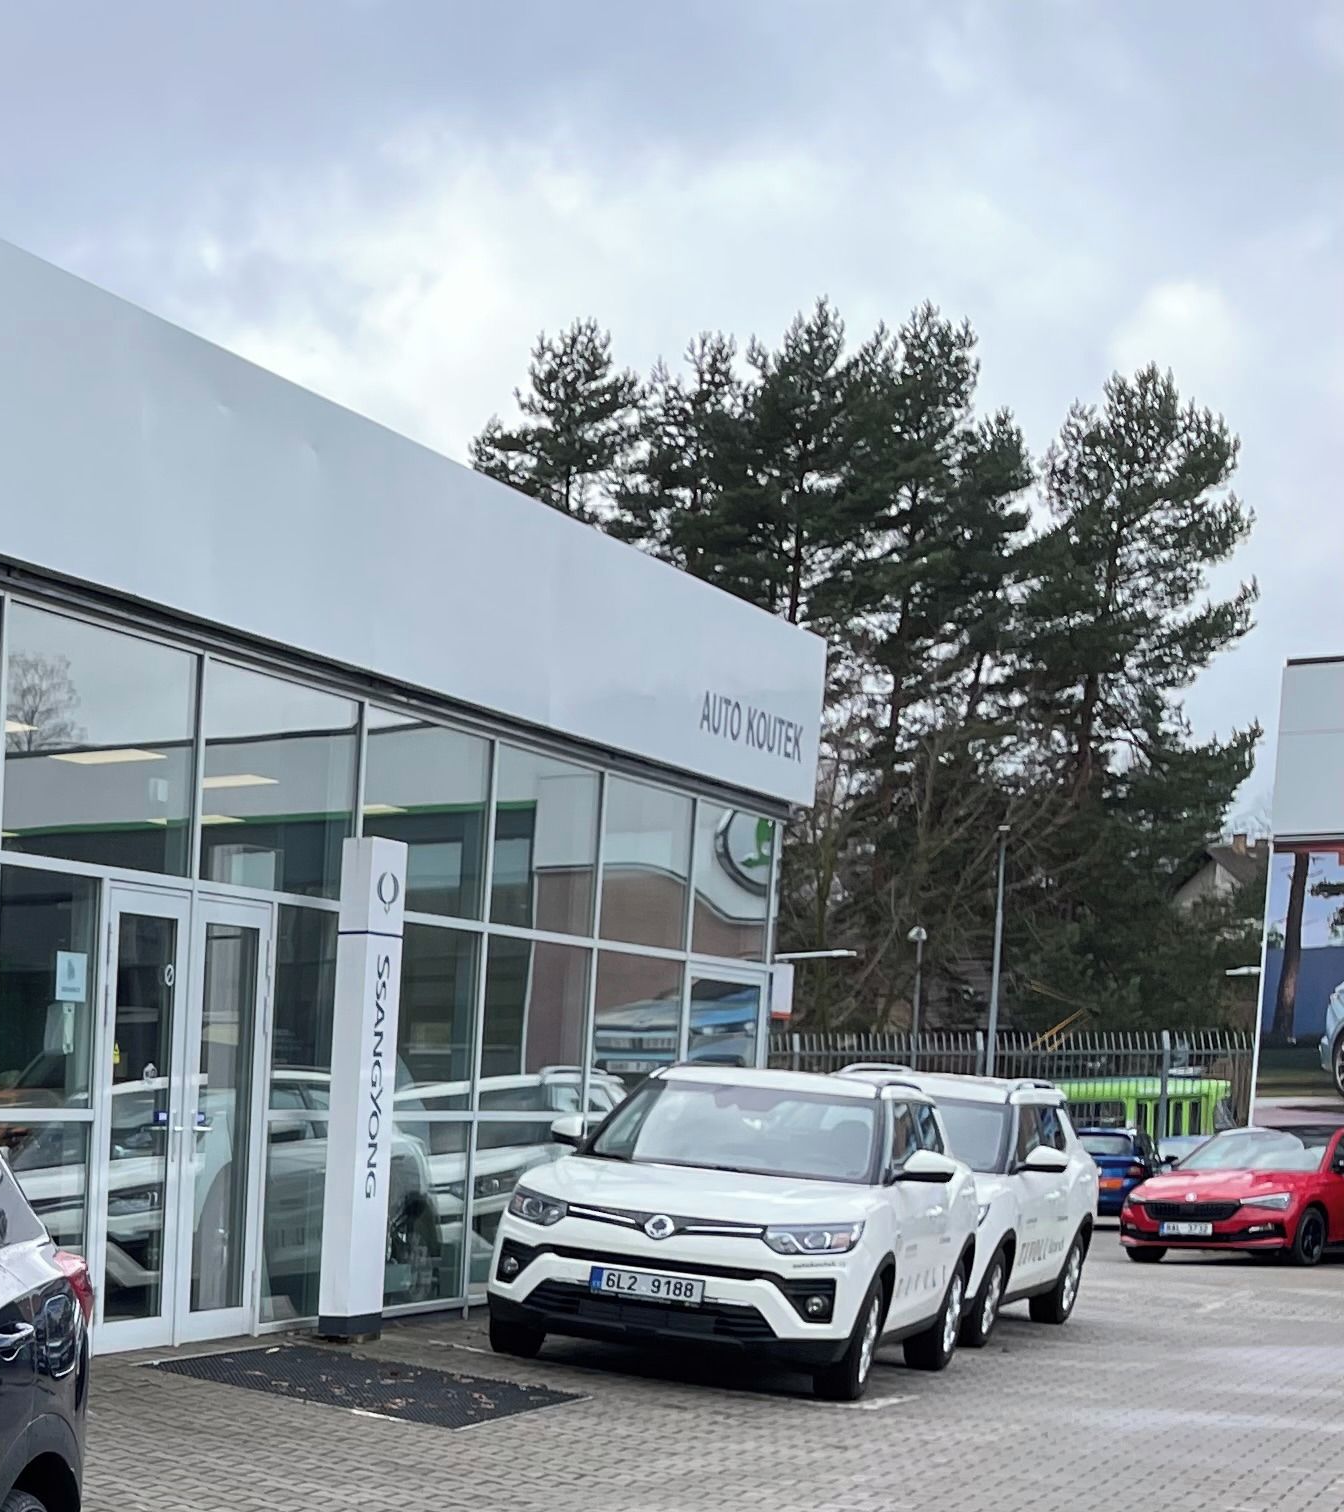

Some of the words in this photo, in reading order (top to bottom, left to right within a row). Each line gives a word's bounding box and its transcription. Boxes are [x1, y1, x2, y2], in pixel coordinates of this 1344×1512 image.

[699, 689, 742, 741] AUTO
[745, 705, 804, 764] KOUTEK
[365, 954, 390, 1199] SSANGYONG
[605, 1272, 638, 1291] 6L2
[650, 1278, 694, 1298] 9188
